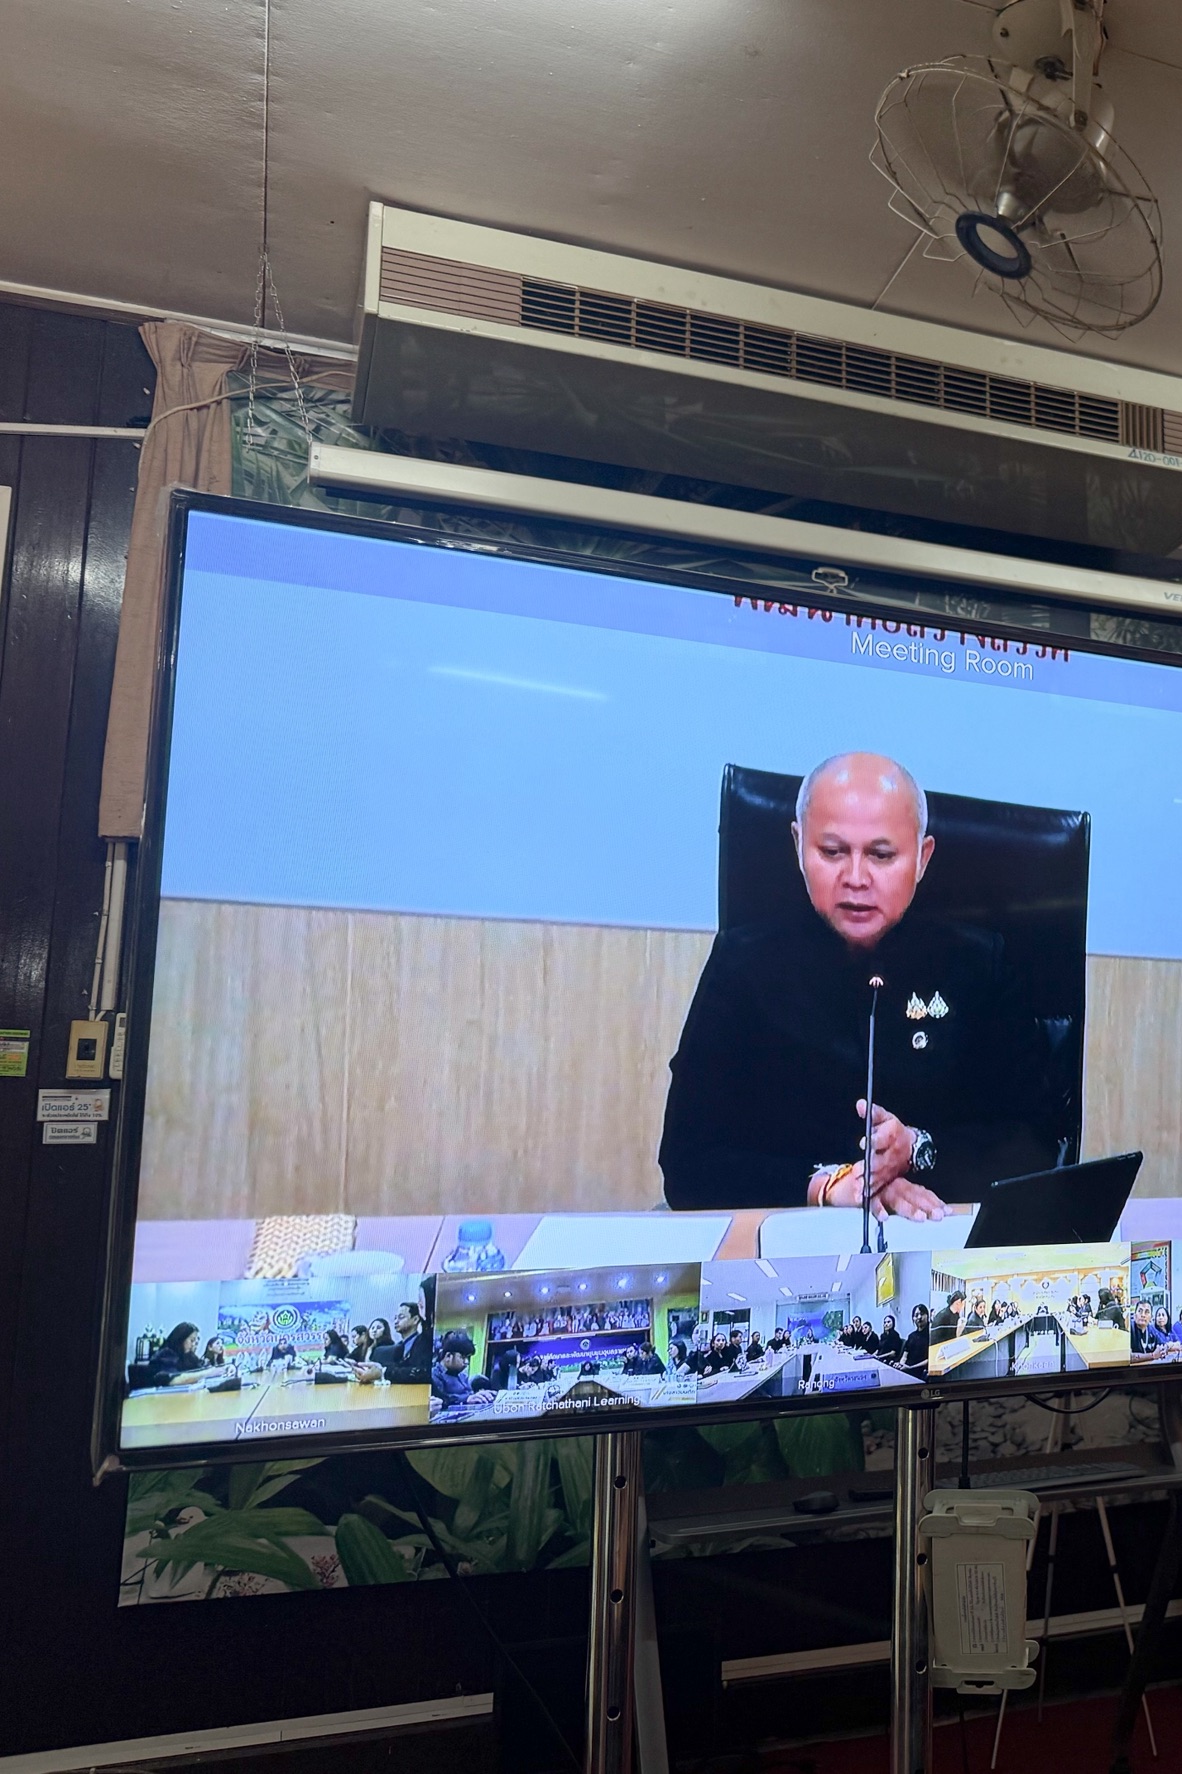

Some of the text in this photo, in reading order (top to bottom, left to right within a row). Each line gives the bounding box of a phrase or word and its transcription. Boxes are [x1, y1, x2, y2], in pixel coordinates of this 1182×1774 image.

[852, 630, 1035, 681] Meeting Room
[798, 1379, 835, 1391] Ranong
[930, 1388, 941, 1397] LG
[528, 1396, 591, 1411] Ratchathani
[593, 1394, 641, 1410] Learning
[234, 1417, 327, 1434] Nakhonsawan
